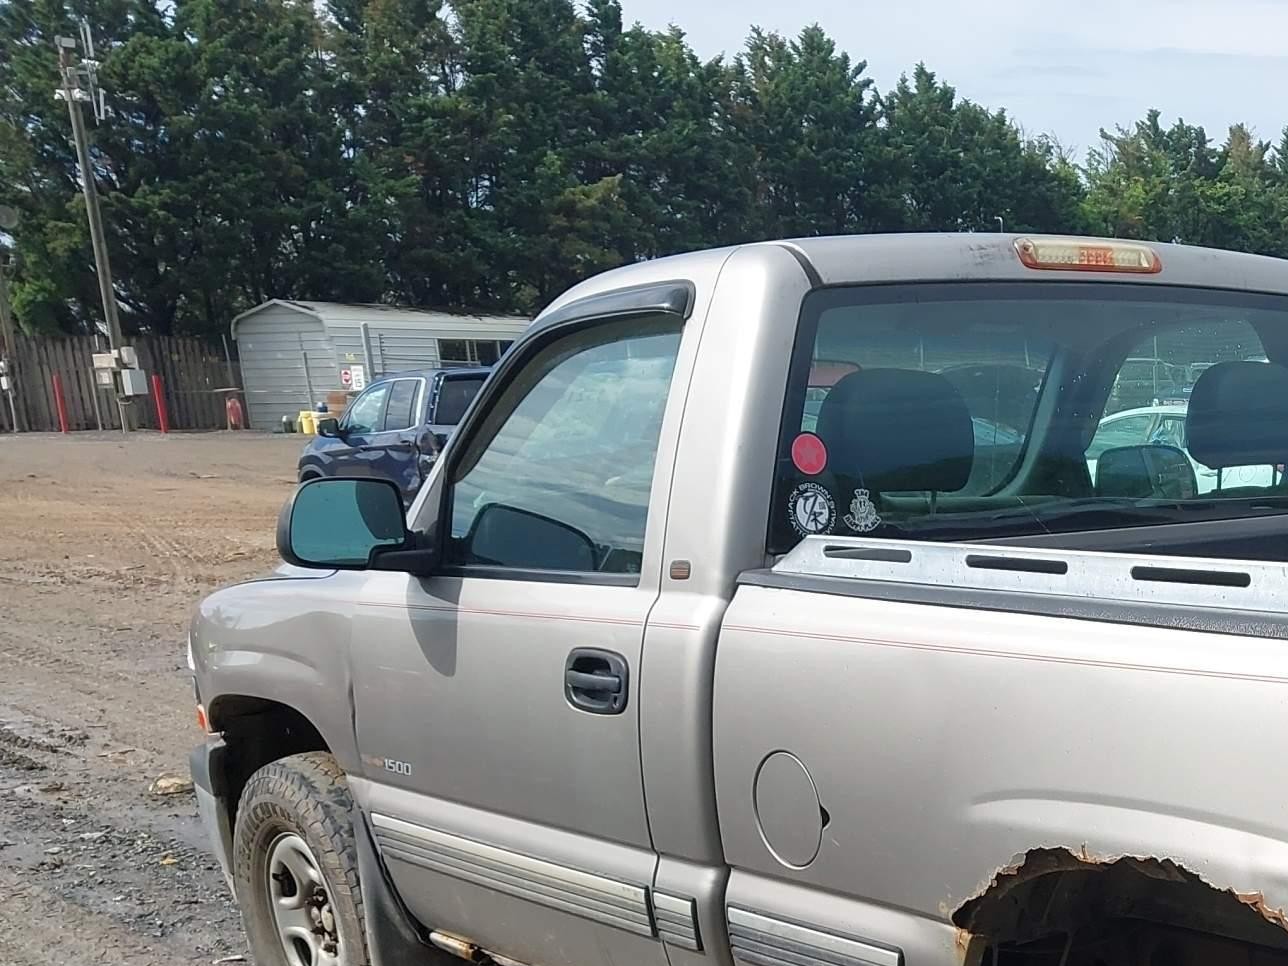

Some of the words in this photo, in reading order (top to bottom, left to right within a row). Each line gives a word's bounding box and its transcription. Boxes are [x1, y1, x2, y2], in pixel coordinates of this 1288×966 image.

[788, 488, 800, 514] JACK
[788, 514, 808, 537] TATTO
[384, 758, 412, 776] 1500
